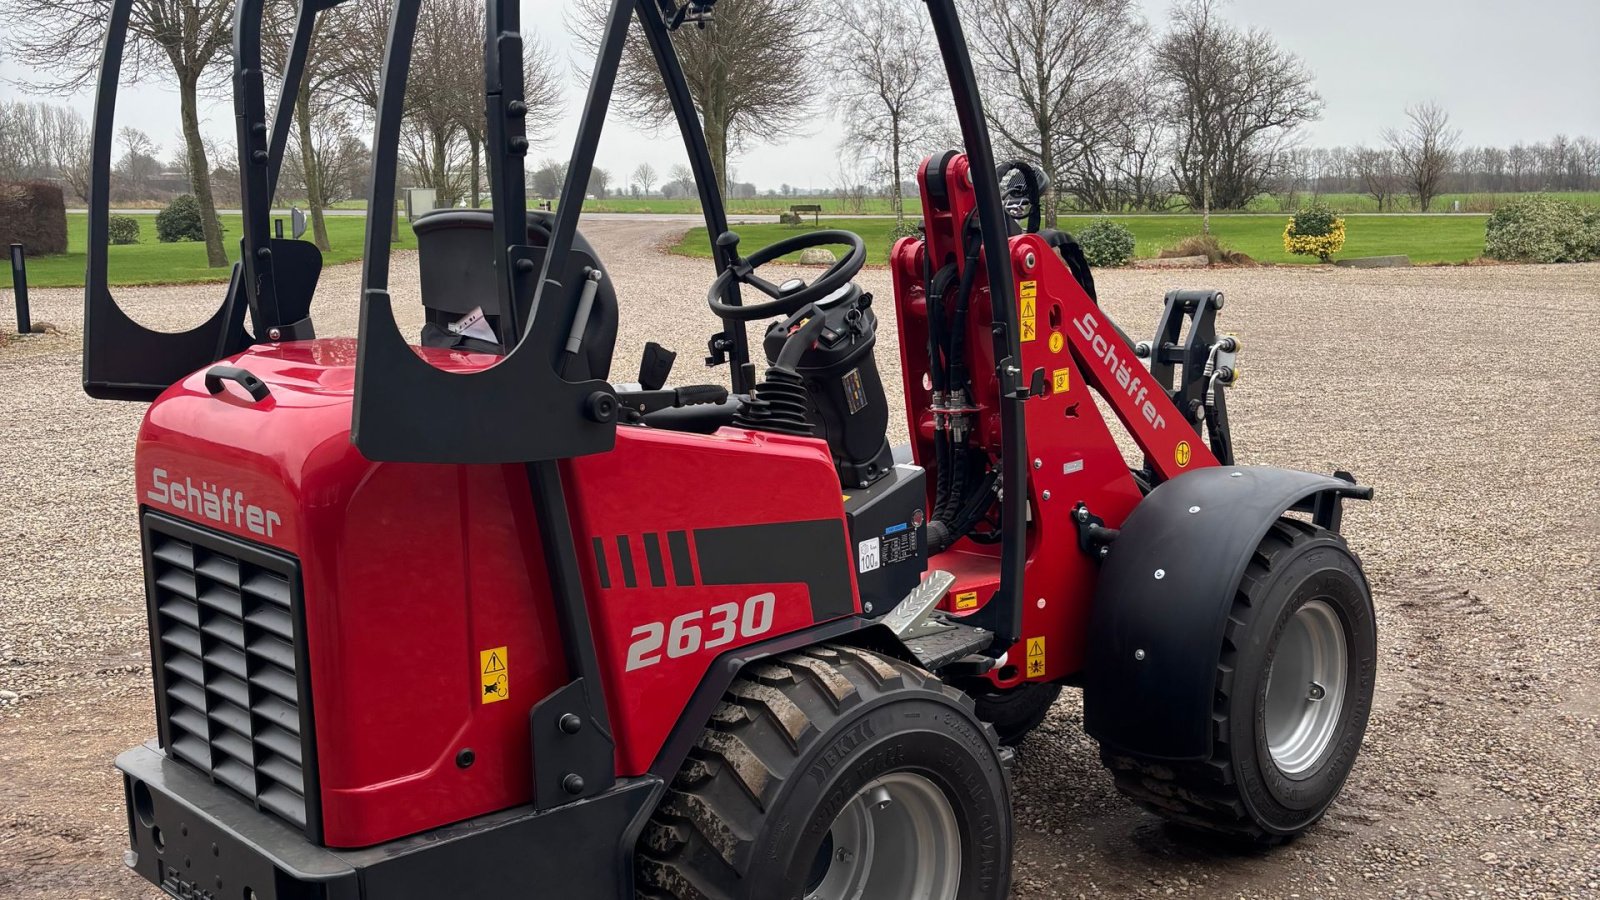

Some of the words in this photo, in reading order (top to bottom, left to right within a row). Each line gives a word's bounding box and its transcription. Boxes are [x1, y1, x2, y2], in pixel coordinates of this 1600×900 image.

[1073, 313, 1167, 430] Schäffer
[146, 467, 281, 538] Schäffer
[860, 553, 875, 570] 100
[626, 592, 776, 671] 2630
[824, 729, 859, 768] BKT
